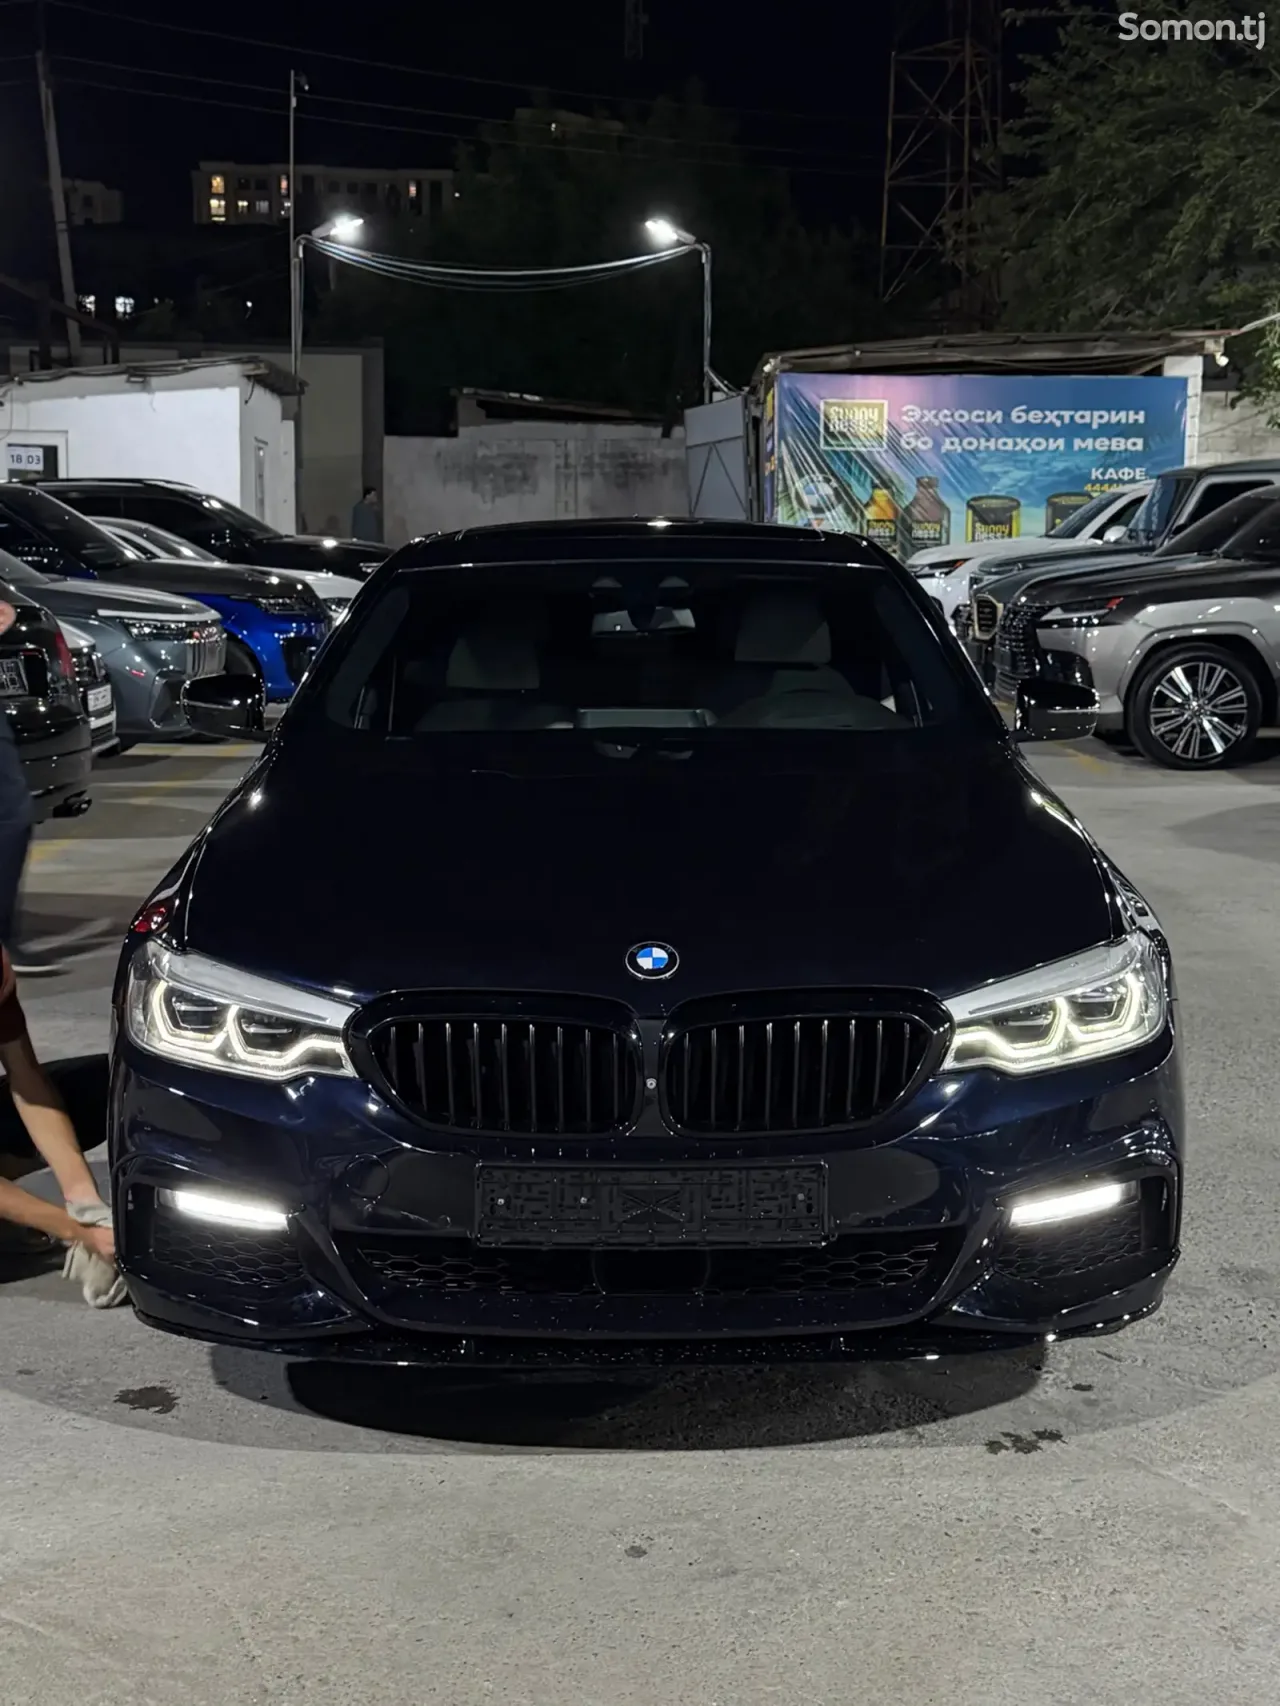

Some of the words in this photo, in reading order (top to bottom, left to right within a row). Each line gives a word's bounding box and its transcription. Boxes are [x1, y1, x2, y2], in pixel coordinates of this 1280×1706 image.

[901, 404, 1002, 426] Эҳсоси
[1011, 405, 1145, 429] беҳтарин
[901, 431, 932, 450] бо
[1073, 436, 1144, 450] мева
[1091, 467, 1146, 480] КАФЕ
